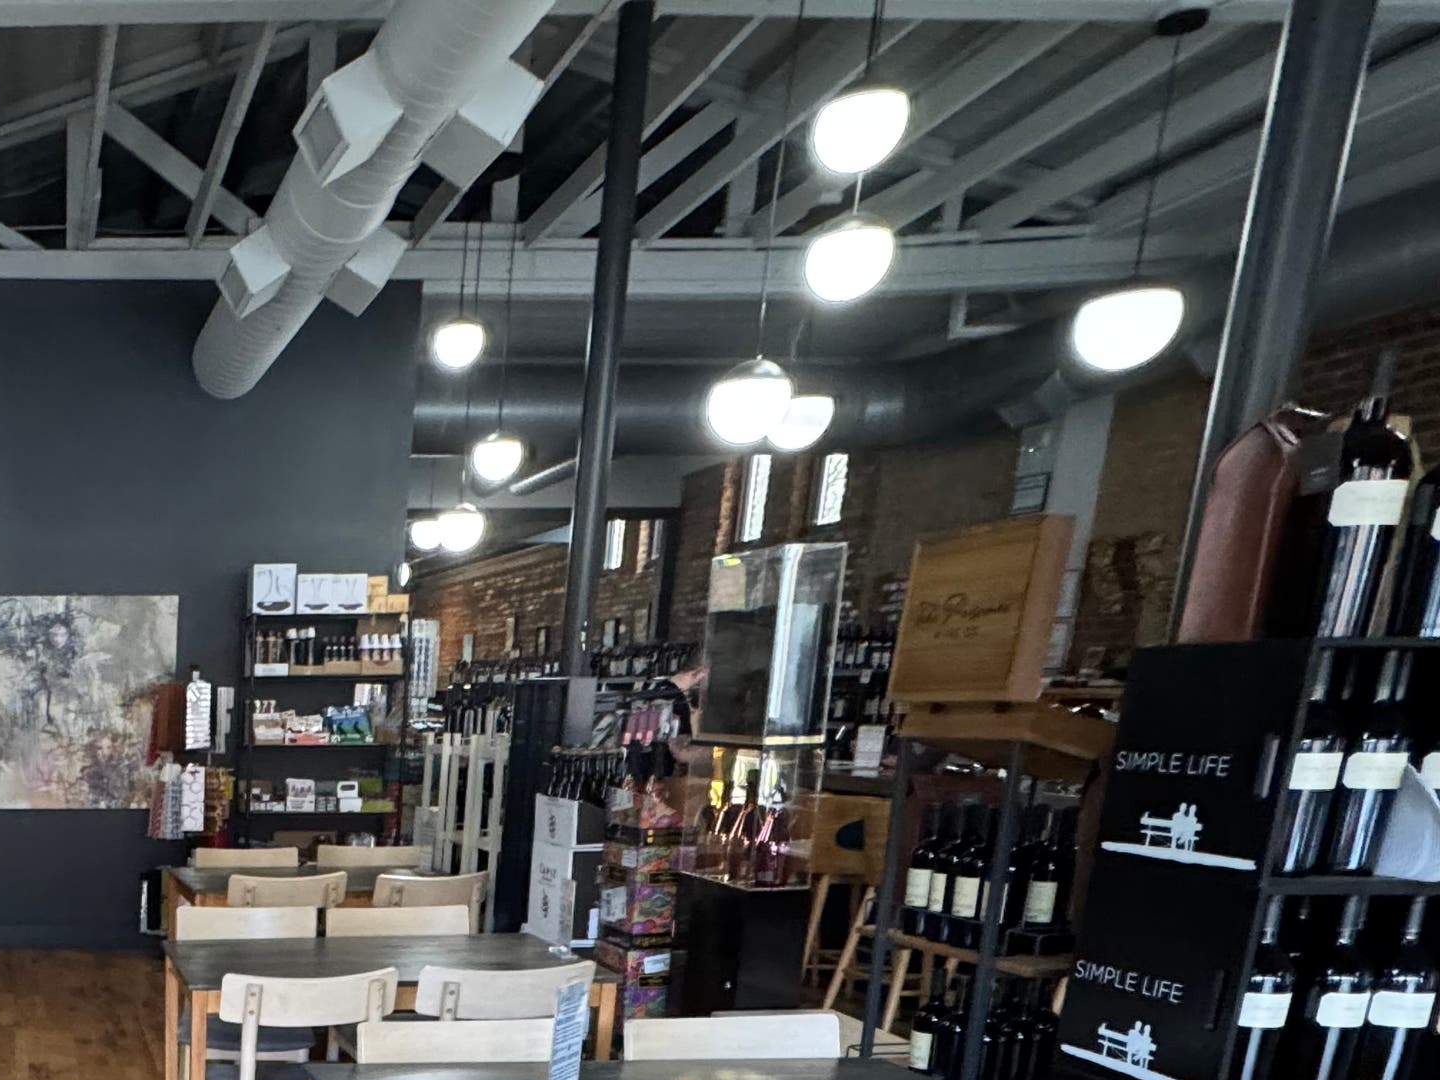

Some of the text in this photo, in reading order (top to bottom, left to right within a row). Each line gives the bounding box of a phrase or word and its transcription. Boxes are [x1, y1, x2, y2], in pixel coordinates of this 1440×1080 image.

[1116, 751, 1231, 777] SIMPLE LIFE
[1075, 960, 1184, 1004] SIMPLE LIFE
